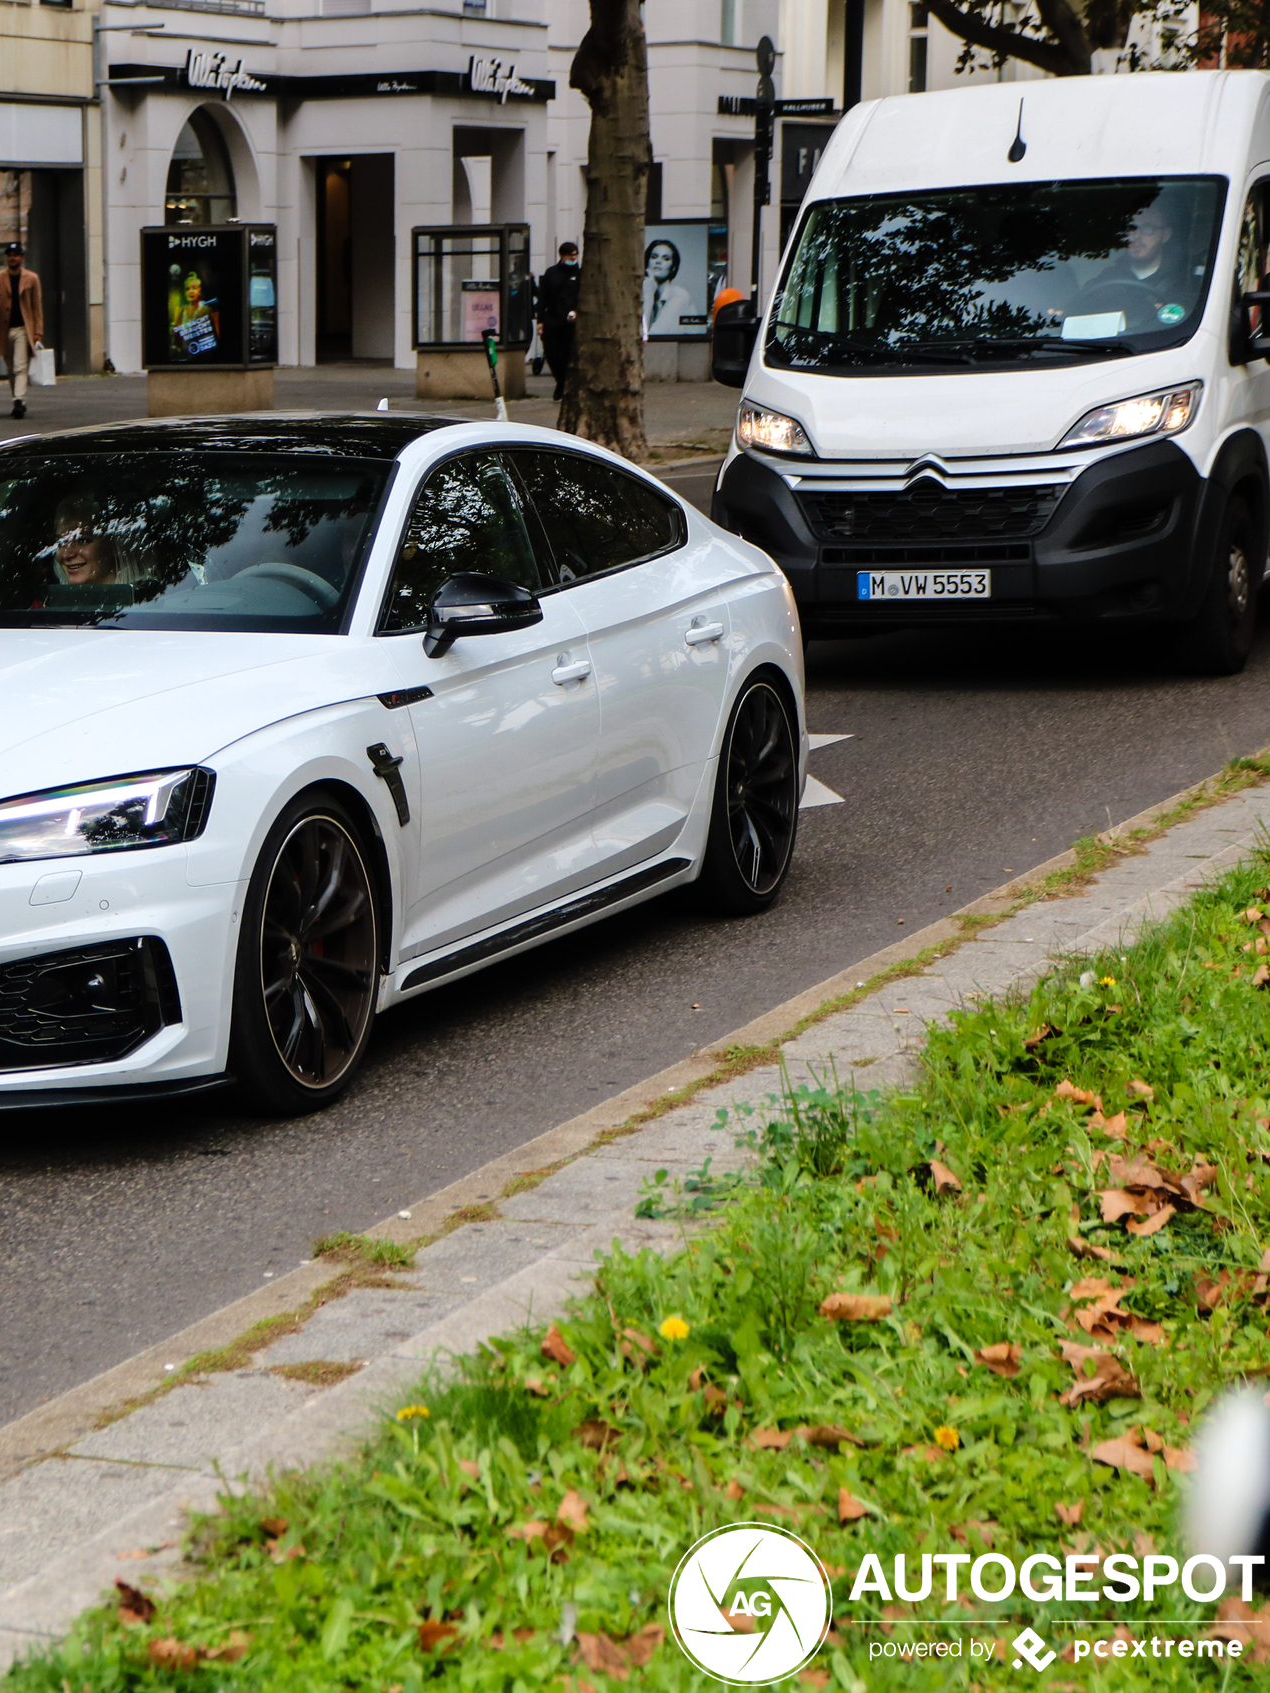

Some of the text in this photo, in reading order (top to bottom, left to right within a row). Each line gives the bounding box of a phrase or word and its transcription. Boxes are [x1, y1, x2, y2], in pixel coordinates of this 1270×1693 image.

[782, 102, 826, 112] HALLHUBER
[182, 236, 217, 247] HYGH
[872, 576, 885, 596] M
[900, 575, 928, 595] VW
[933, 574, 986, 594] 5553
